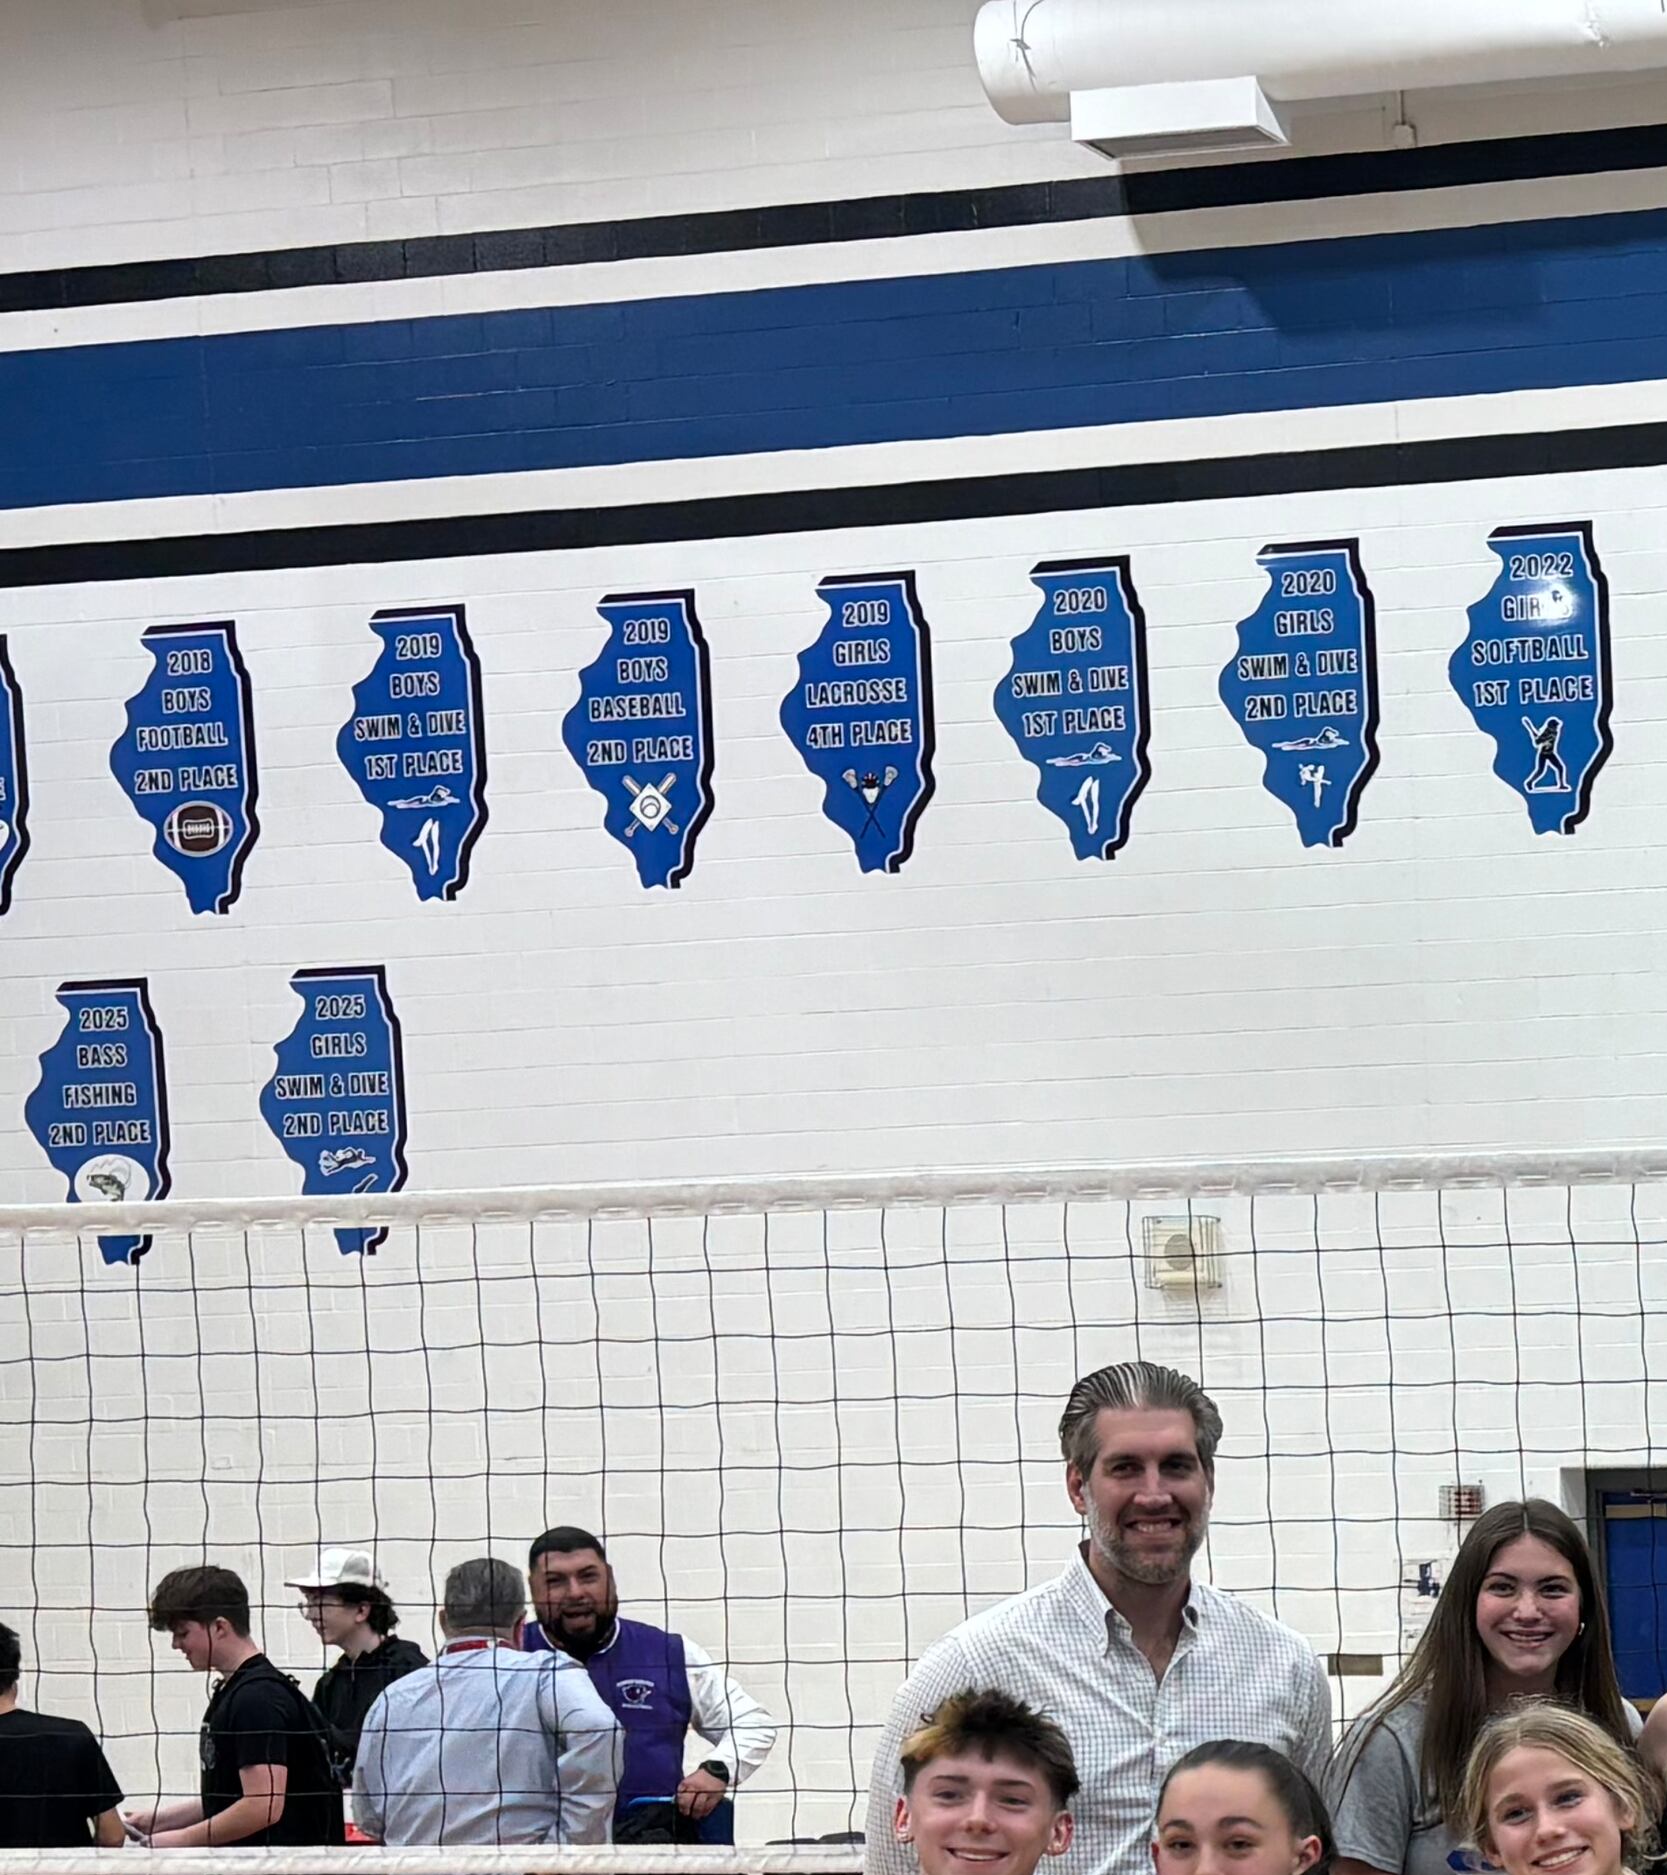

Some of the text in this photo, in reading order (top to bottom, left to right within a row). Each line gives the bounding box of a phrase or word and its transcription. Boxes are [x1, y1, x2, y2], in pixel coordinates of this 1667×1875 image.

[1509, 552, 1574, 581] 2022
[1282, 569, 1336, 597] 2020
[843, 600, 890, 627] 2019
[1054, 587, 1107, 615] 2020
[624, 618, 670, 644] 2019
[1274, 608, 1334, 637] GIRLS
[396, 633, 441, 660] 2019
[833, 639, 890, 666] GIRLS
[1050, 626, 1102, 654] BOYS
[1472, 634, 1588, 665] SOFTBALL
[167, 649, 212, 676] 2018
[618, 656, 668, 683] BOYS
[1238, 649, 1357, 681] SWIM & DIVE
[390, 671, 440, 698] BOYS
[806, 678, 907, 708] LACROSSE
[1012, 665, 1128, 698] SWIM & DIVE
[1473, 675, 1593, 706] 1ST PLACE
[162, 687, 211, 713] BOYS
[589, 692, 686, 721] BASEBALL
[1245, 689, 1357, 721] 2ND PLACE
[355, 710, 466, 741] SWIM & DIVE
[807, 719, 912, 748] 4TH PLACE
[1022, 706, 1126, 737] 1ST PLACE
[137, 722, 228, 751] FOOTBALL
[587, 736, 693, 765] 2ND PLACE
[365, 750, 463, 779] 1ST PLACE
[135, 764, 238, 794] 2ND PLACE
[79, 1007, 129, 1031] 2025
[316, 994, 366, 1020] 2025
[77, 1043, 127, 1068] BASS
[310, 1032, 367, 1058] GIRLS
[63, 1082, 136, 1108] FISHING
[275, 1070, 389, 1099] SWIM & DIVE
[49, 1120, 151, 1147] 2ND PLACE
[283, 1110, 389, 1137] 2ND PLACE
